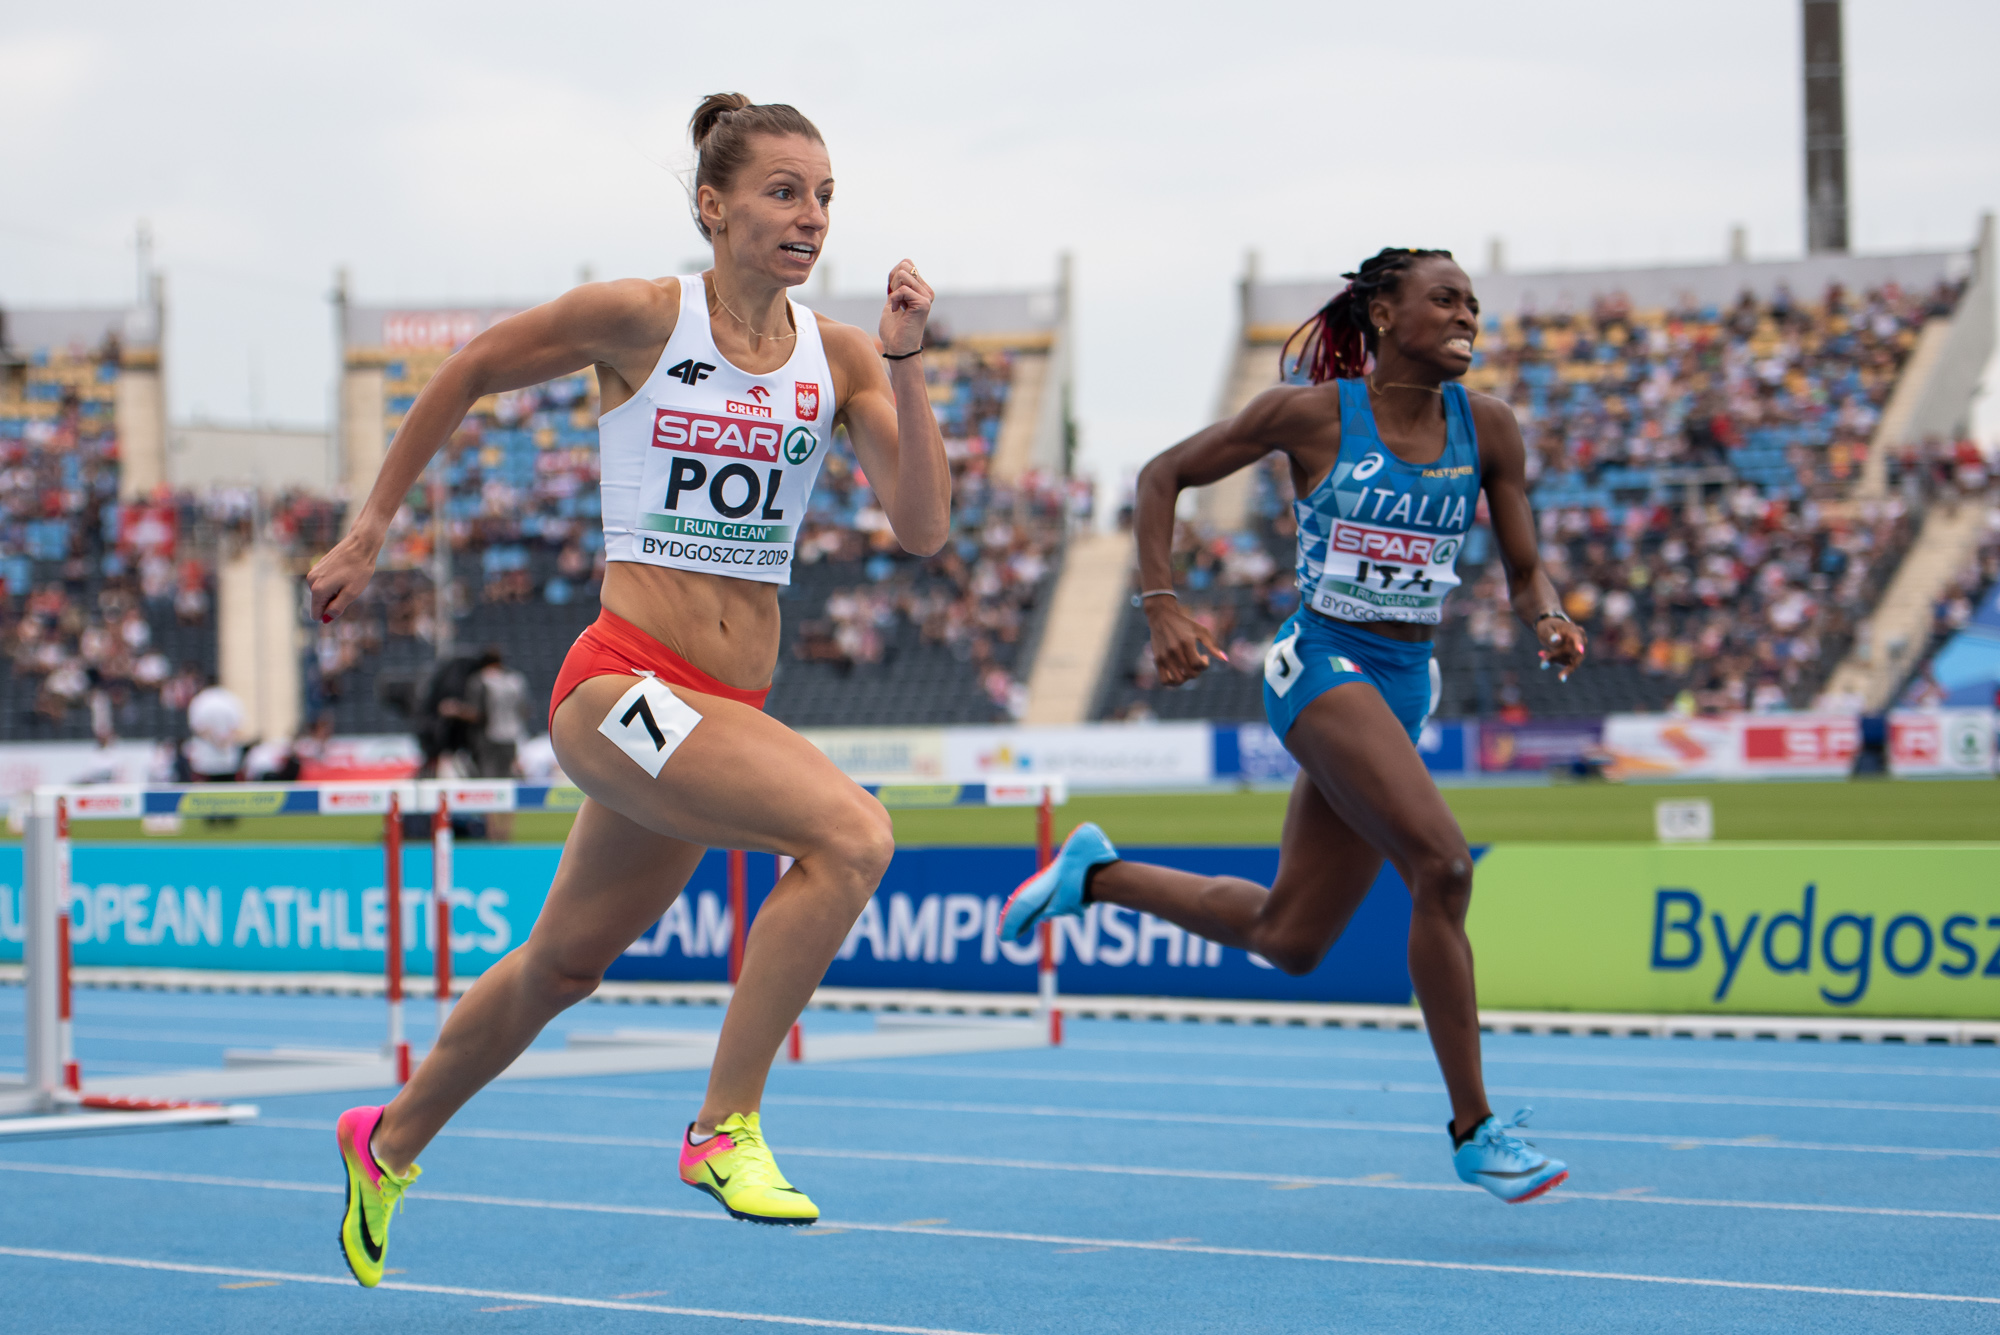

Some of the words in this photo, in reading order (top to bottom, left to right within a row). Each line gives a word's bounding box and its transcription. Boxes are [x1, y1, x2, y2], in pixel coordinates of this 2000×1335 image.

[666, 359, 717, 386] 4F
[728, 402, 769, 418] ORLEN
[656, 414, 780, 457] SPAR
[664, 456, 783, 520] POL
[1351, 486, 1467, 530] ITALIA
[674, 518, 680, 531] I
[683, 519, 718, 537] RUN
[642, 537, 756, 566] BYDGOSZCZ
[756, 549, 789, 566] 2019
[1335, 529, 1434, 563] SPAR
[1355, 560, 1434, 592] ITA
[1356, 587, 1383, 605] RUN
[1385, 594, 1420, 607] CLEAN
[619, 693, 667, 753] 7
[0, 883, 223, 947] UOPEAN
